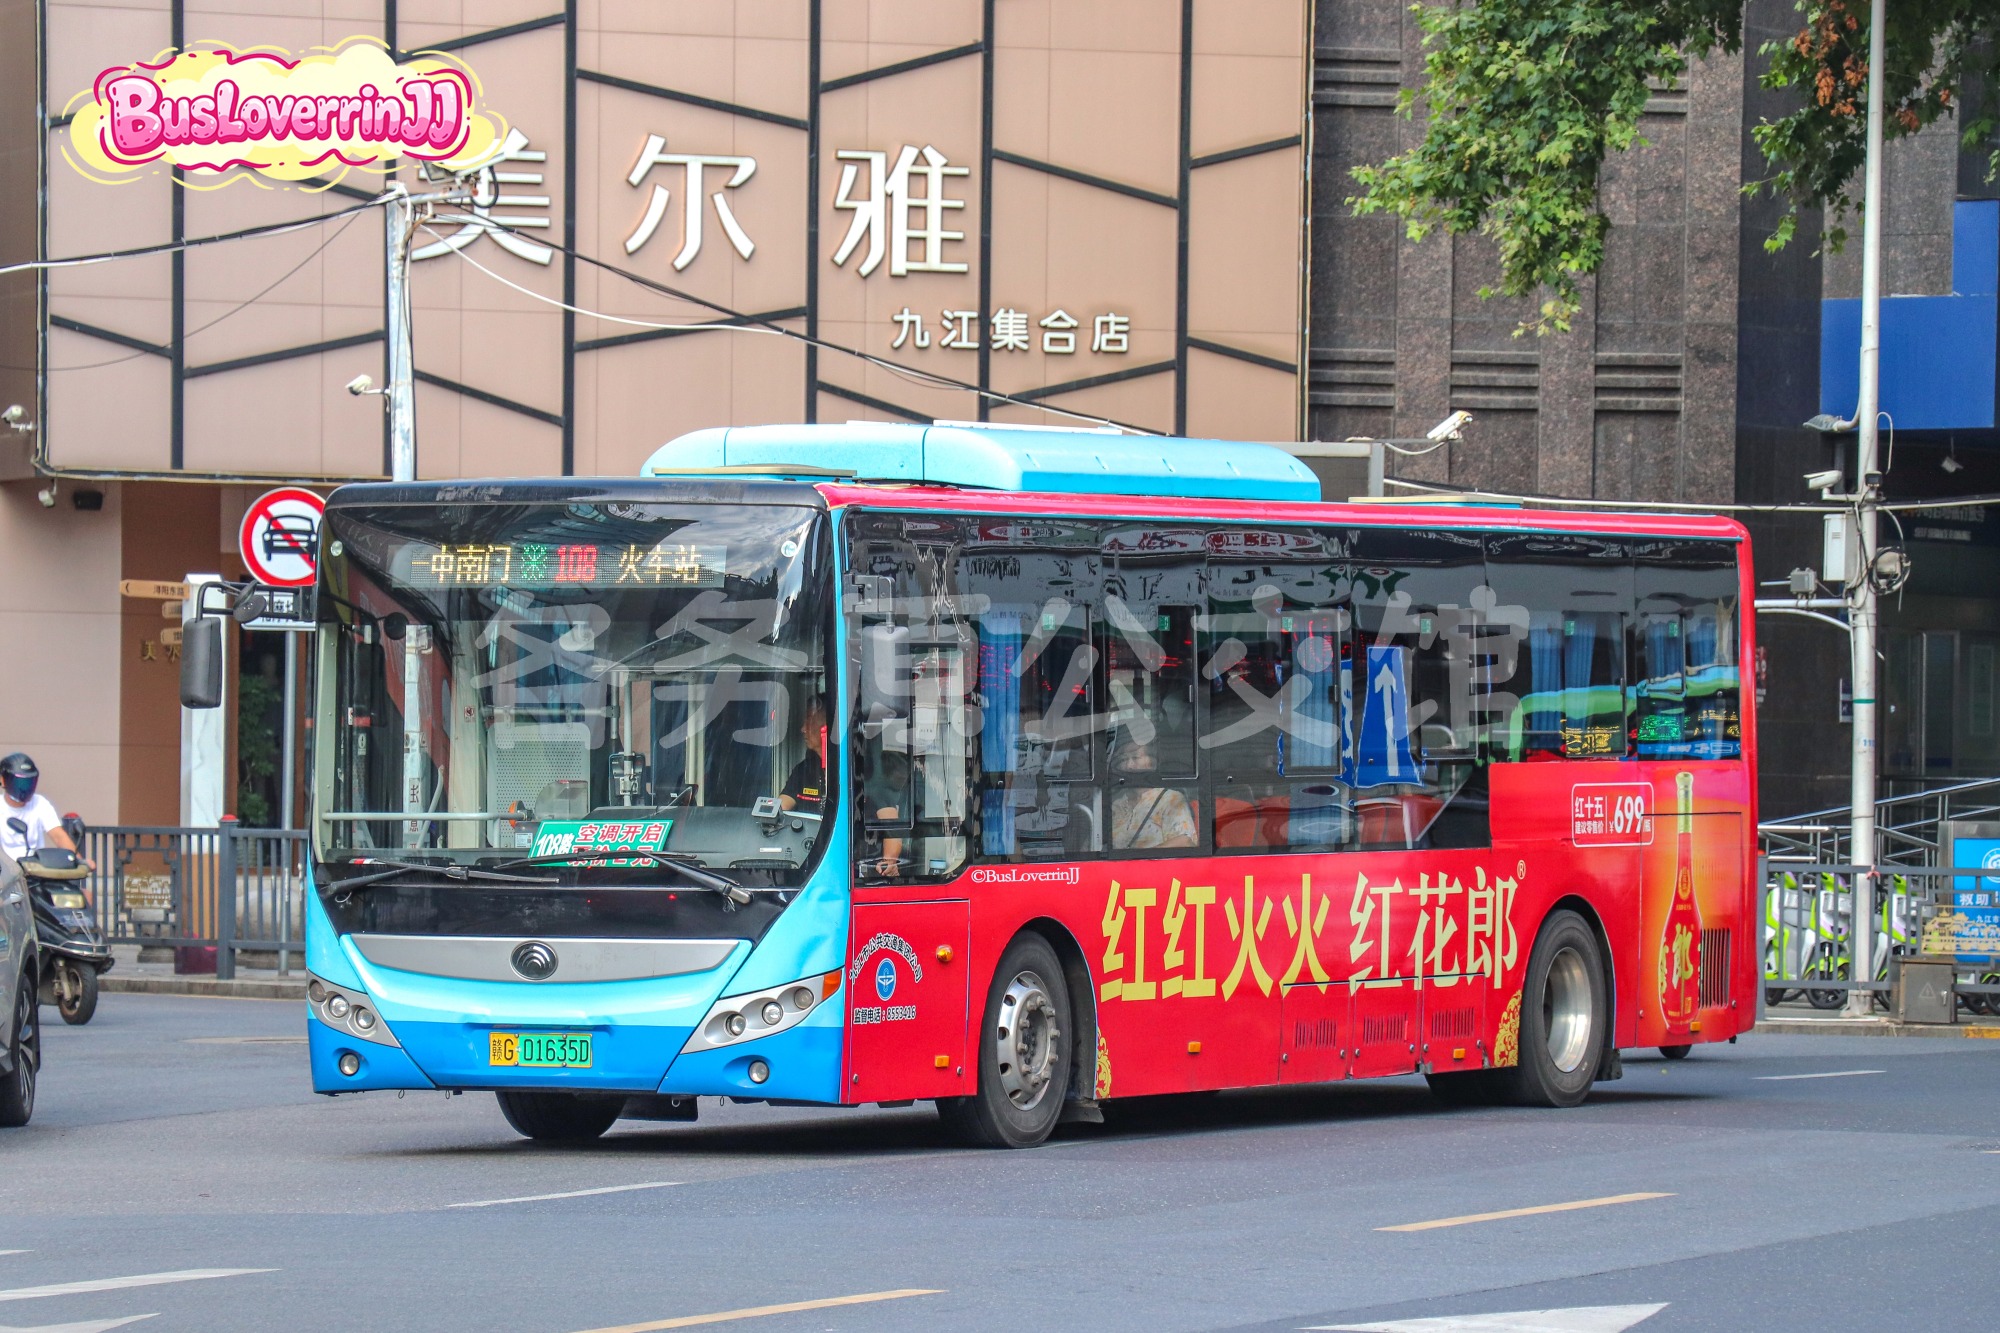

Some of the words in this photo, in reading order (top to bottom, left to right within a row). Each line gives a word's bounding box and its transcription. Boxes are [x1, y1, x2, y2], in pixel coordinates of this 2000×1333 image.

[411, 126, 970, 278] 美尔雅
[892, 307, 1130, 354] 九江集合店
[555, 545, 597, 583] 108
[616, 544, 702, 584] 火车站
[1575, 796, 1604, 818] 红十五
[575, 823, 664, 842] 空调开启
[1101, 874, 1331, 1002] 红红火火
[523, 1037, 589, 1063] 01635D
